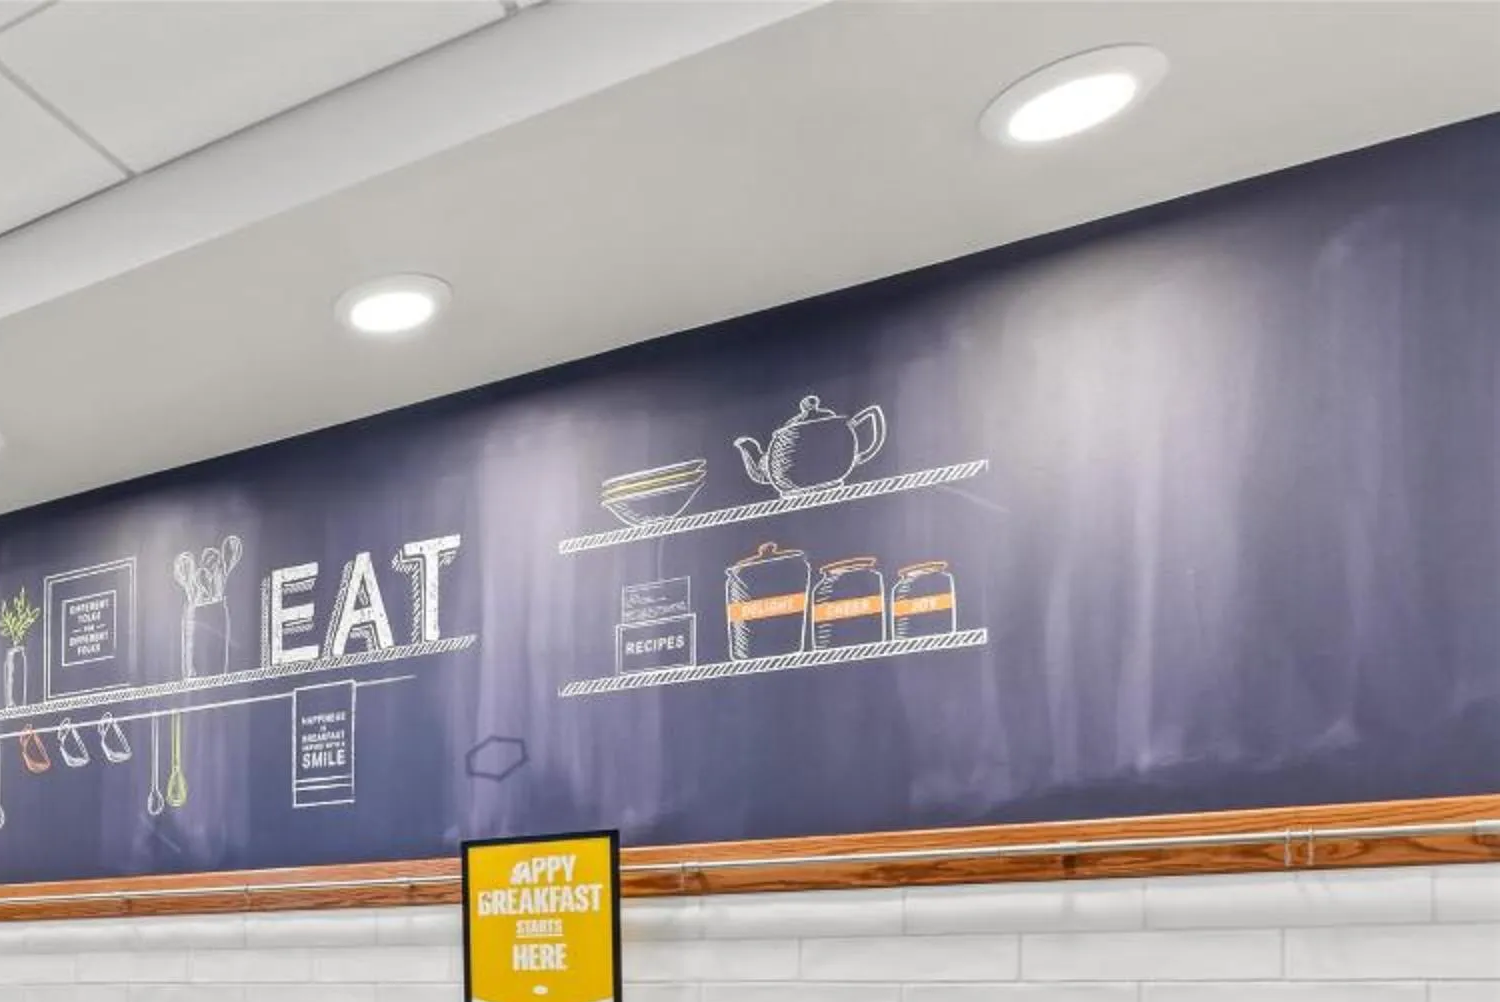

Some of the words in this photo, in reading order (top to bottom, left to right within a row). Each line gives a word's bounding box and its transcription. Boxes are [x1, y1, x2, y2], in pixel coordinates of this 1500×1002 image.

[262, 534, 461, 667] EAT
[625, 635, 685, 655] RECIPES
[301, 749, 346, 769] SMILE
[478, 883, 603, 916] BREAKFAST
[512, 943, 568, 971] HERE
